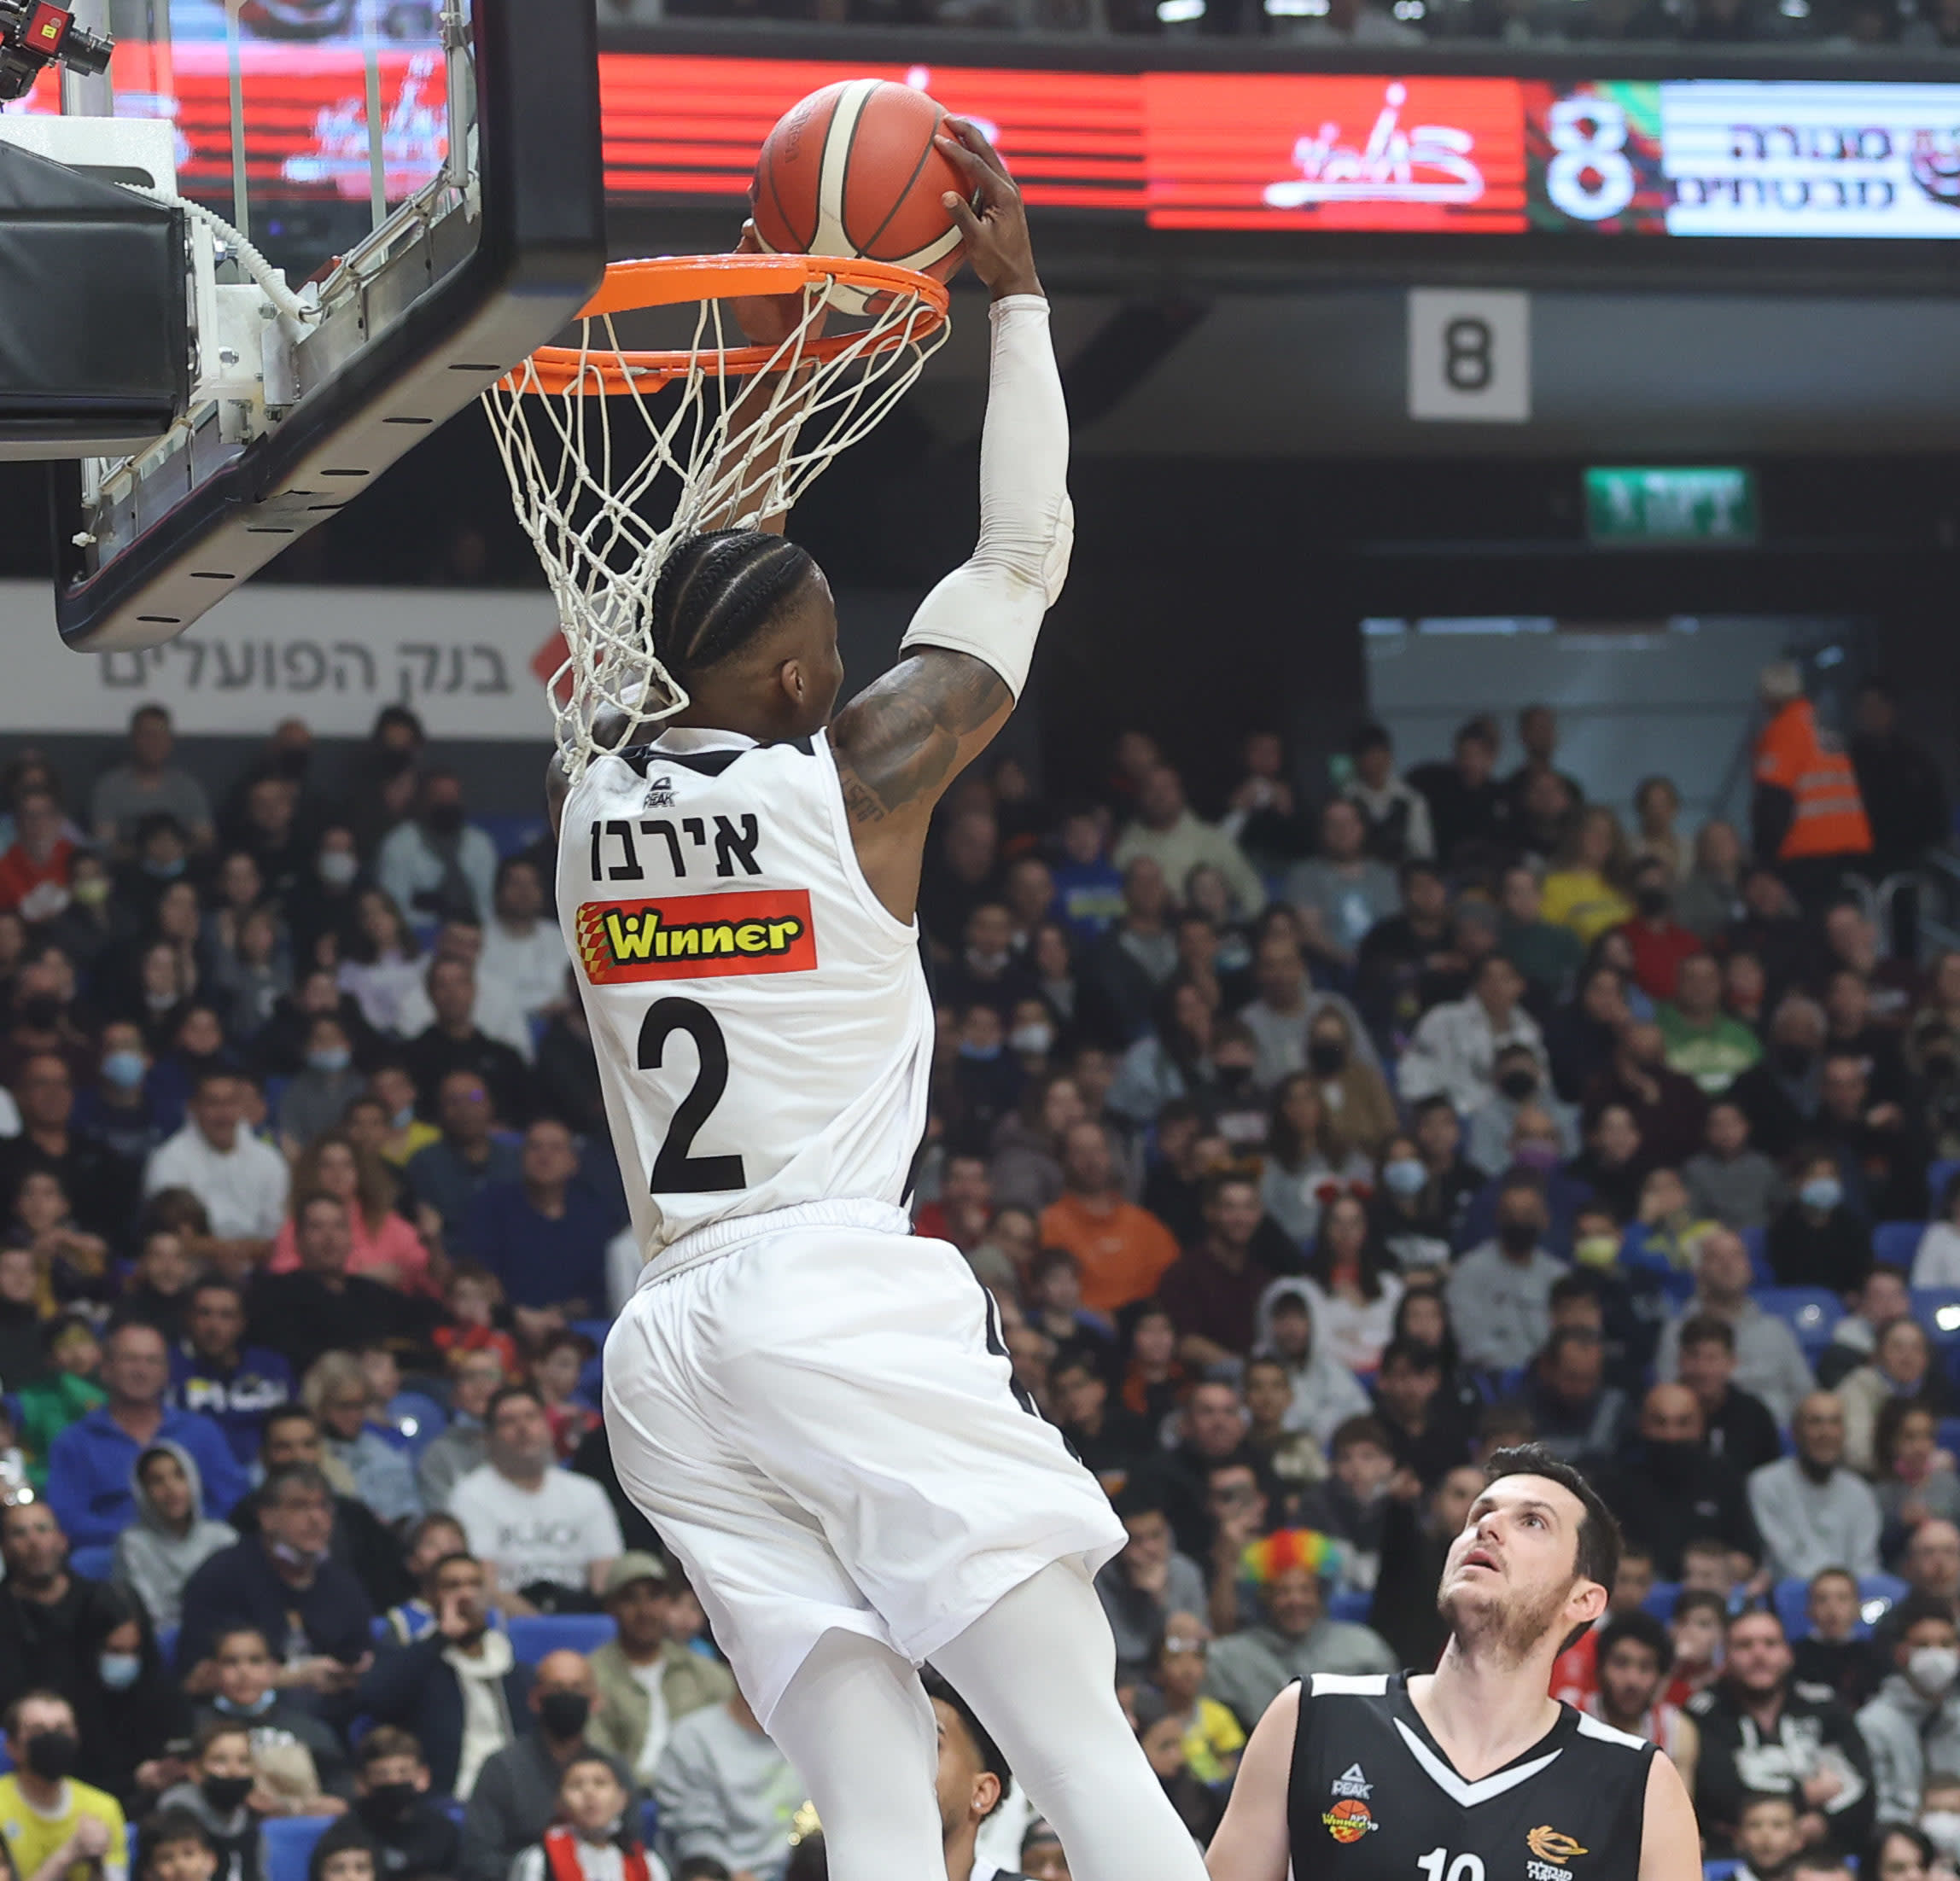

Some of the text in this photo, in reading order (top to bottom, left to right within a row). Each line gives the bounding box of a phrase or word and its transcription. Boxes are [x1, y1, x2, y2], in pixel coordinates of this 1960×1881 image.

[1547, 98, 1635, 220] 8
[1444, 315, 1493, 392] 8
[396, 640, 513, 706] בנק
[642, 790, 680, 810] PEAK
[604, 911, 801, 962] Winner
[638, 997, 747, 1194] 2
[1331, 1779, 1374, 1800] PEAK
